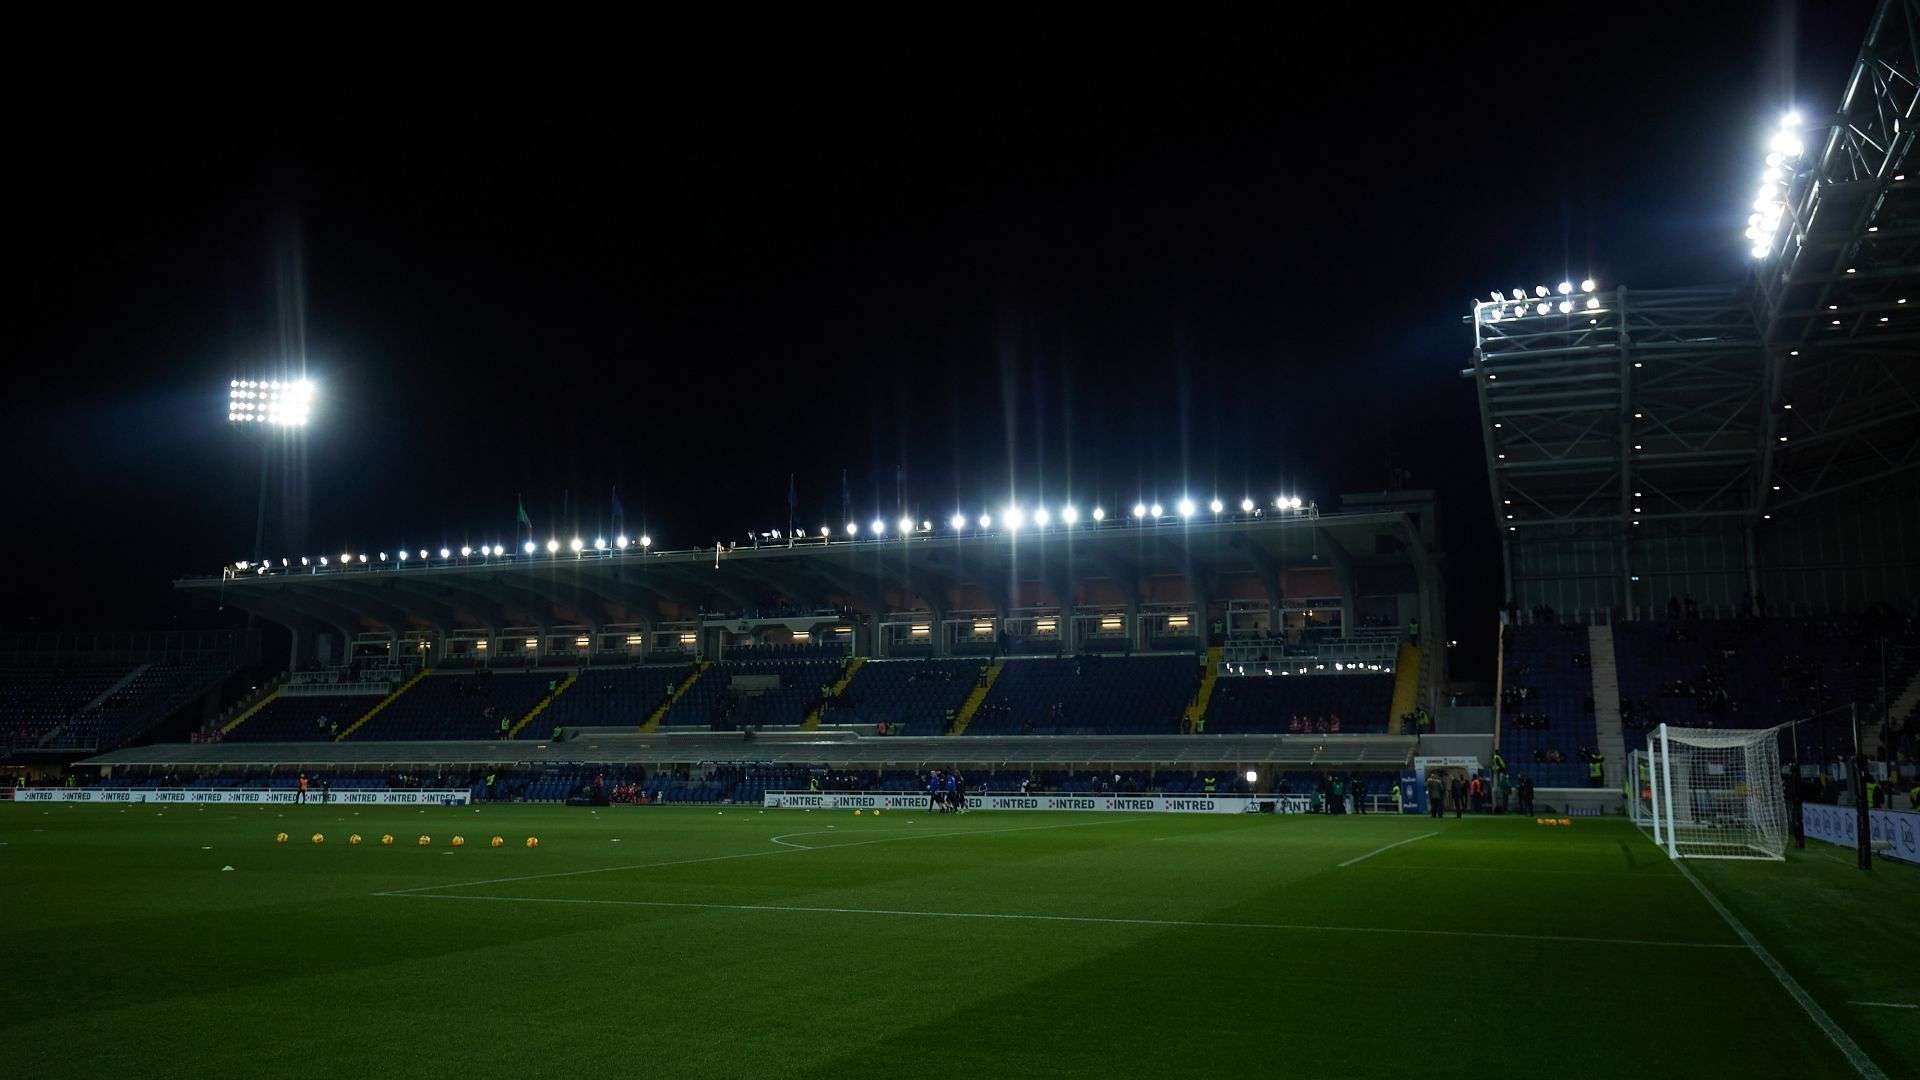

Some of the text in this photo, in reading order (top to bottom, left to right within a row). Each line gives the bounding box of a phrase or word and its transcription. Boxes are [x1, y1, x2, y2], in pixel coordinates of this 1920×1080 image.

[29, 792, 53, 800] INTRED
[66, 792, 91, 801] INTRED
[105, 793, 130, 801] INTRED
[160, 794, 185, 802] INTRED
[196, 794, 222, 802] INTRED
[233, 794, 260, 802] INTRED
[349, 794, 377, 803] INTRED
[389, 794, 417, 803] INTRED
[839, 797, 875, 806] INTRED
[891, 798, 928, 807] INTRED
[999, 799, 1038, 809] INTRED
[1056, 799, 1095, 809] INTRED
[1114, 800, 1154, 810] INTRED
[1173, 800, 1215, 810] INTRED
